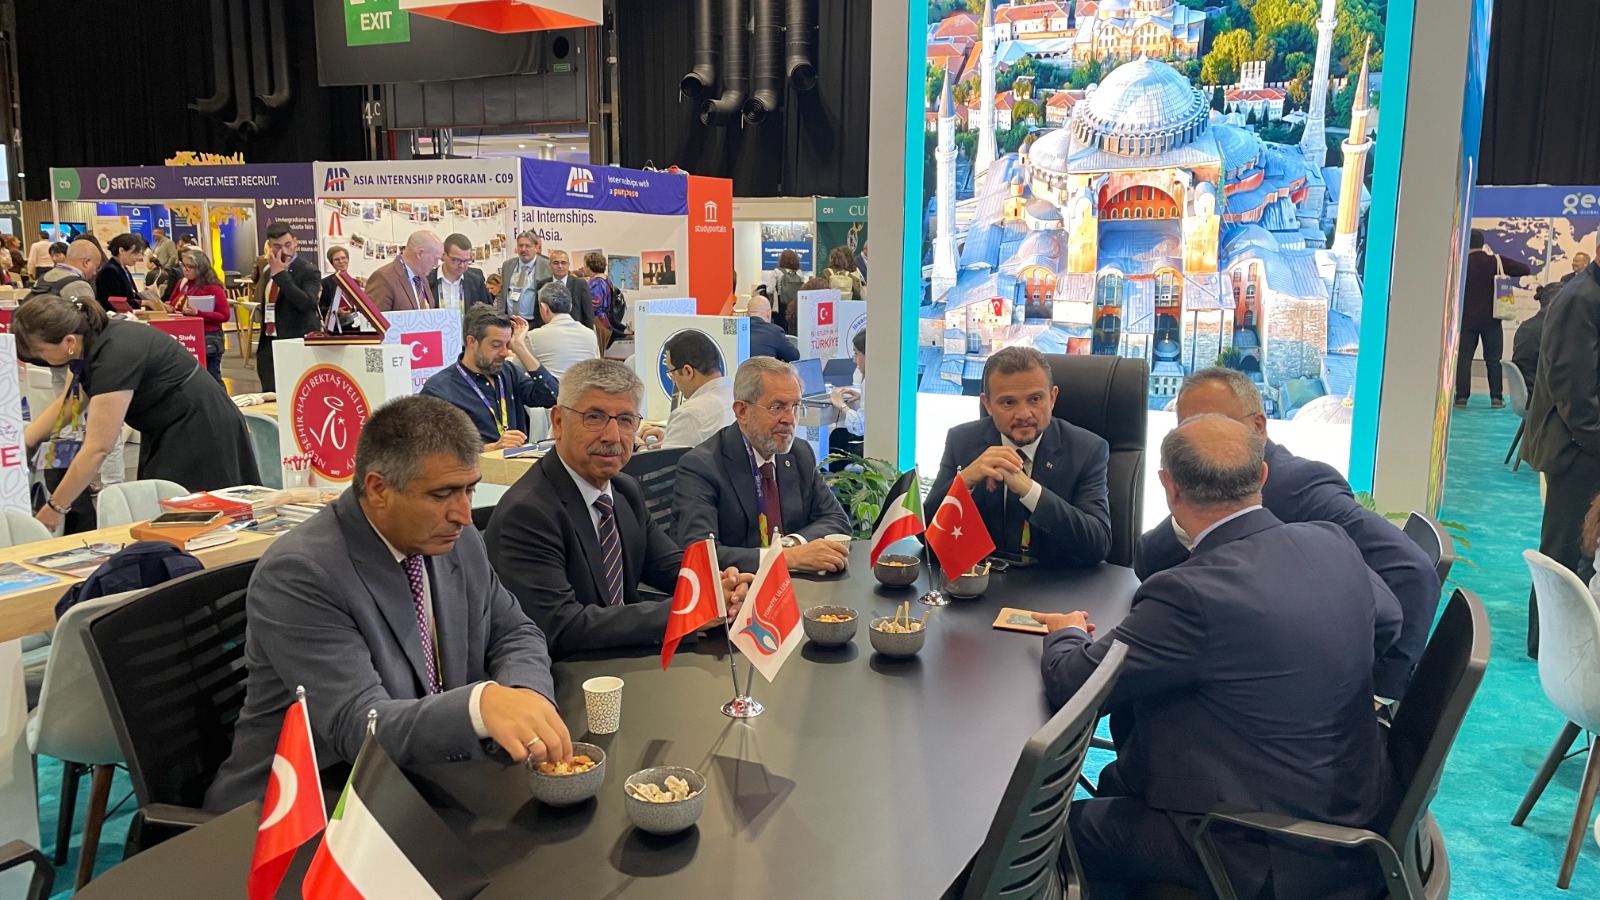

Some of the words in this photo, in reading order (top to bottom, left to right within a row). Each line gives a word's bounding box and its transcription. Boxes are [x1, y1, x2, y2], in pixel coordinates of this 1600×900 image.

[360, 11, 392, 31] EXIT
[111, 177, 156, 189] SRTFAIRS
[324, 167, 351, 192] AIP
[353, 173, 374, 185] ASIA
[377, 174, 434, 185] INTERNSHIP
[436, 173, 486, 184] PROGRAM
[495, 172, 514, 184] C09
[607, 175, 638, 188] Internships
[639, 179, 650, 188] with
[613, 188, 639, 198] purpose
[848, 205, 867, 216] CU
[537, 209, 597, 226] Internships.
[538, 228, 563, 241] Asia.
[694, 225, 727, 233] studyportals
[392, 356, 404, 367] E7
[309, 373, 341, 388] BEKTAŞ
